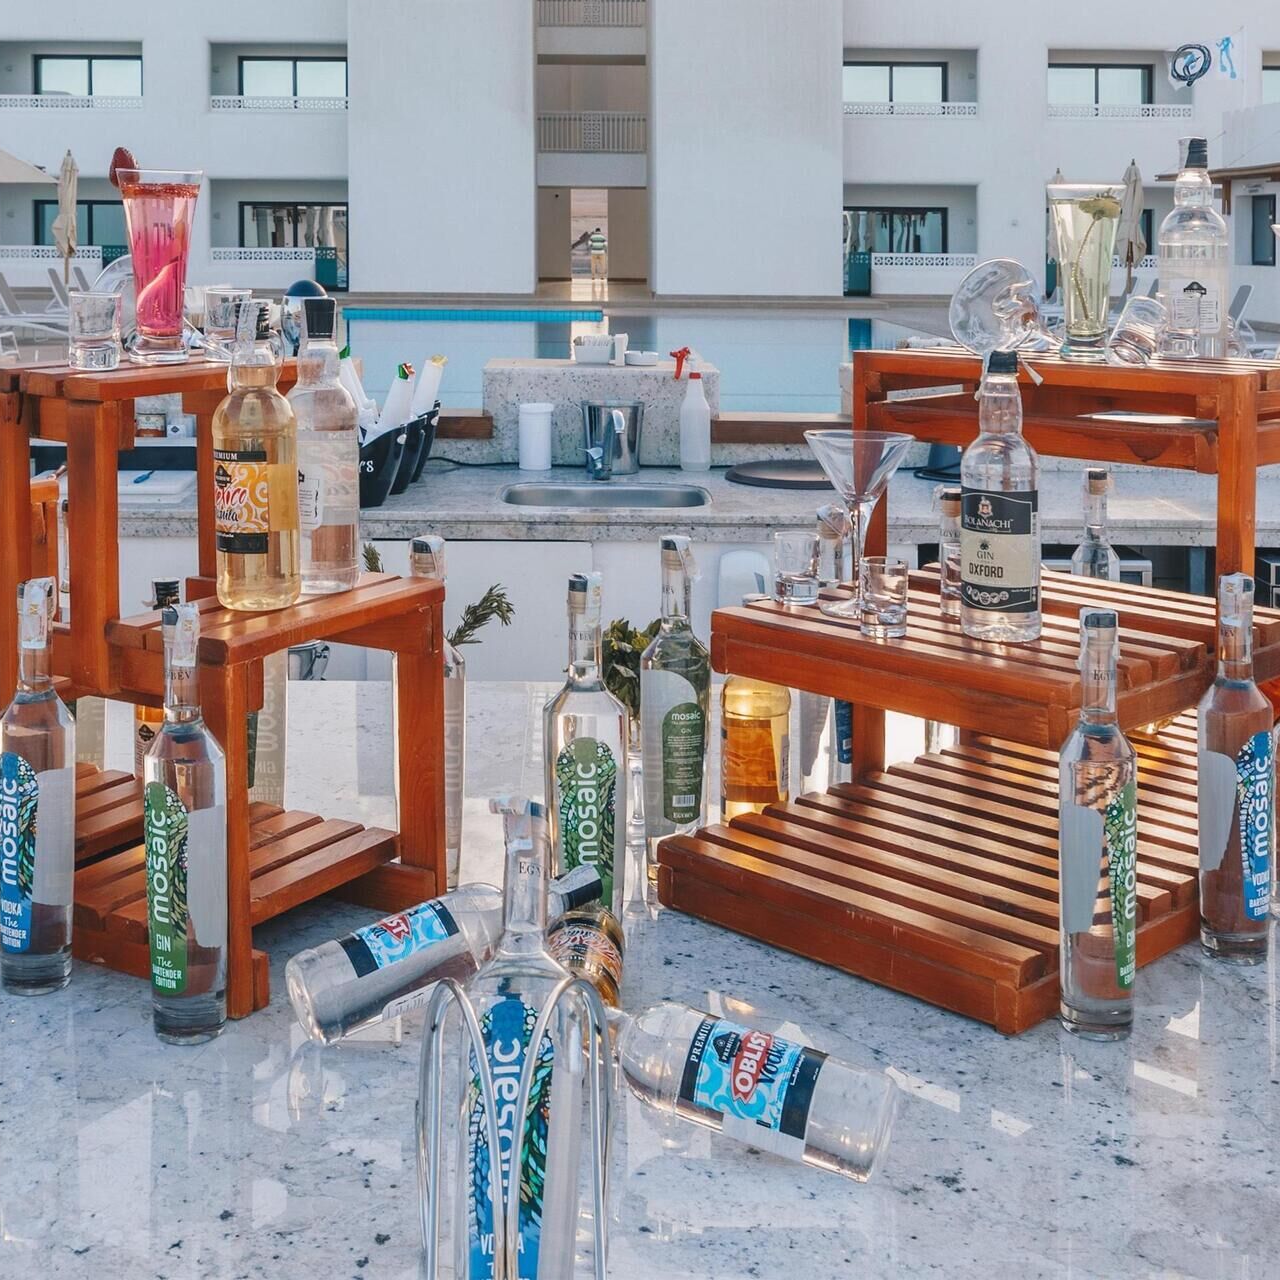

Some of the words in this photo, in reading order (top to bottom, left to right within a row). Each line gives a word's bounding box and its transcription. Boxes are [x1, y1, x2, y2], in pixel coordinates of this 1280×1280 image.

[976, 551, 995, 561] GIN
[968, 562, 1004, 579] OXFORD
[671, 711, 701, 721] mosaic
[577, 762, 597, 866] mosaic
[1253, 755, 1268, 857] mosaic
[0, 777, 17, 886] mosaic
[153, 809, 170, 923] mosaic
[1122, 808, 1136, 920] mosaic
[1, 899, 23, 917] VODKA
[3, 917, 19, 928] The
[156, 933, 171, 952] GIN
[156, 956, 174, 968] The
[155, 976, 177, 989] EDITION
[735, 1031, 772, 1093] OBLIST
